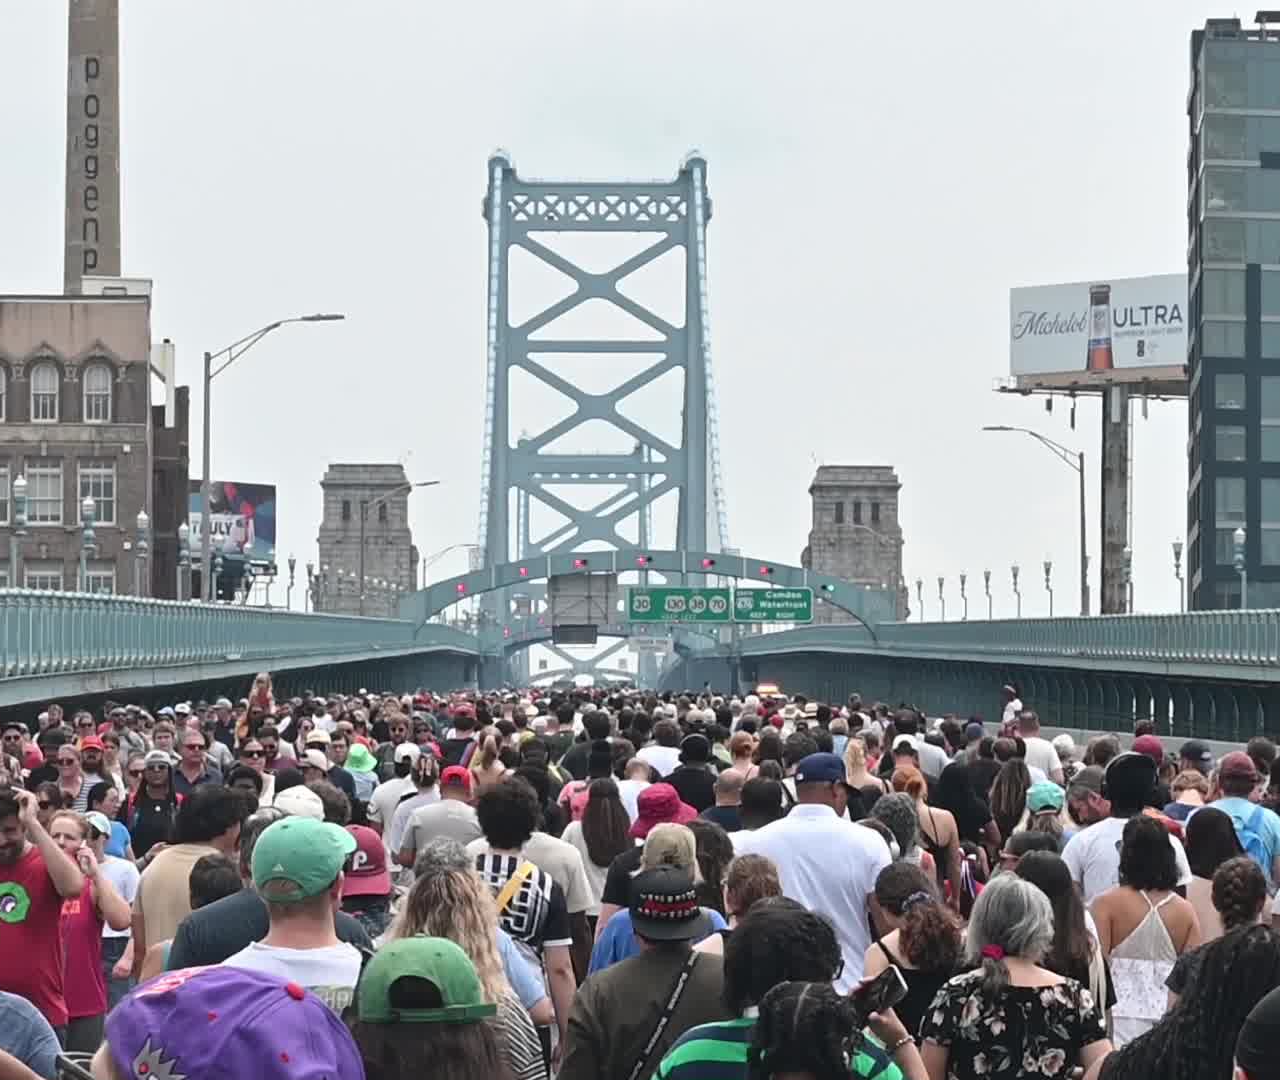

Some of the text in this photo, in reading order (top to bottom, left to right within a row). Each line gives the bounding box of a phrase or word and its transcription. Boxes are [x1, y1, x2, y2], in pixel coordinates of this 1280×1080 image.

[1112, 303, 1183, 328] ULTRA
[1013, 311, 1088, 341] Michelob
[765, 590, 802, 600] Camden
[635, 599, 649, 610] 30
[711, 599, 725, 610] 70
[759, 600, 807, 610] Waterfront
